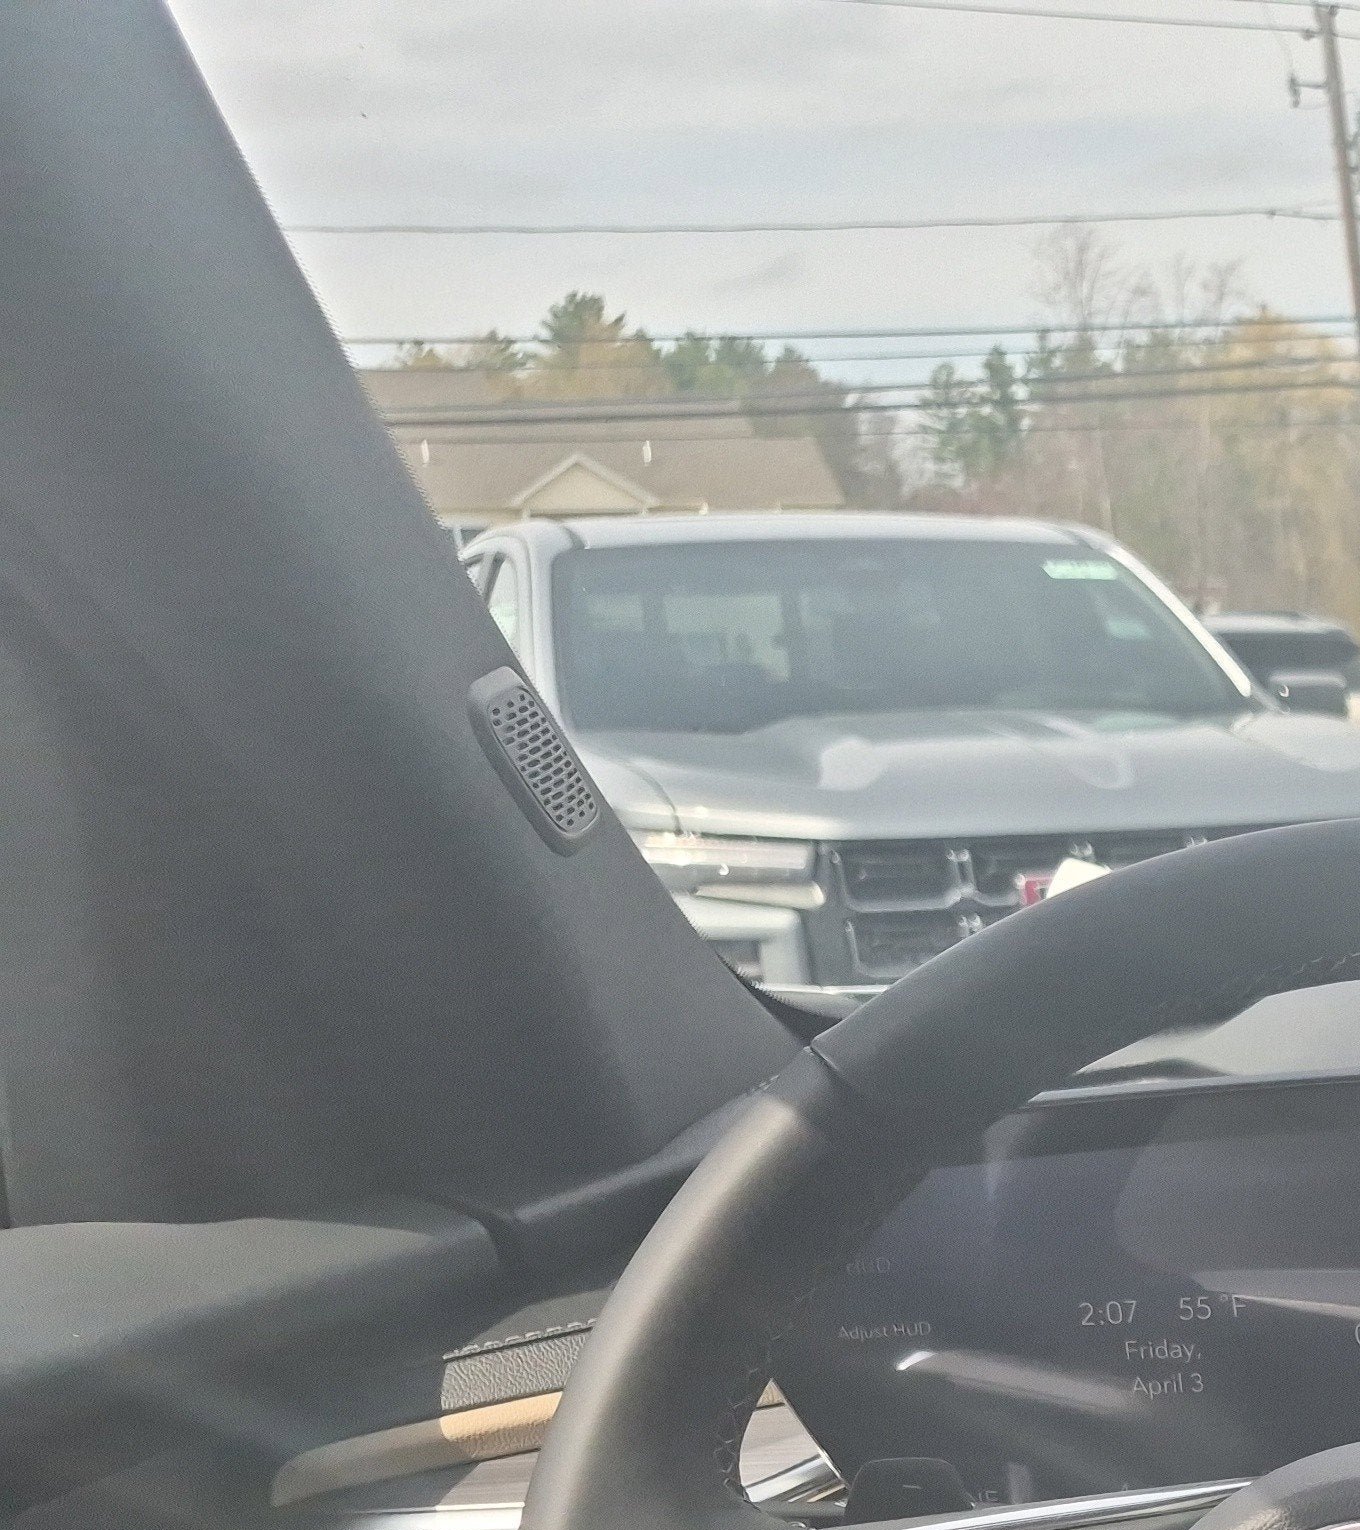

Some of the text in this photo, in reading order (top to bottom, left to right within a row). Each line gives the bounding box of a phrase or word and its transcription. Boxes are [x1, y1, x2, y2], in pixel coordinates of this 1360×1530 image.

[1078, 1300, 1137, 1326] 2:07
[1178, 1297, 1212, 1320] 55
[838, 1320, 933, 1343] Adjust HUD
[1125, 1339, 1202, 1362] Friday,
[1132, 1372, 1205, 1399] April 3
